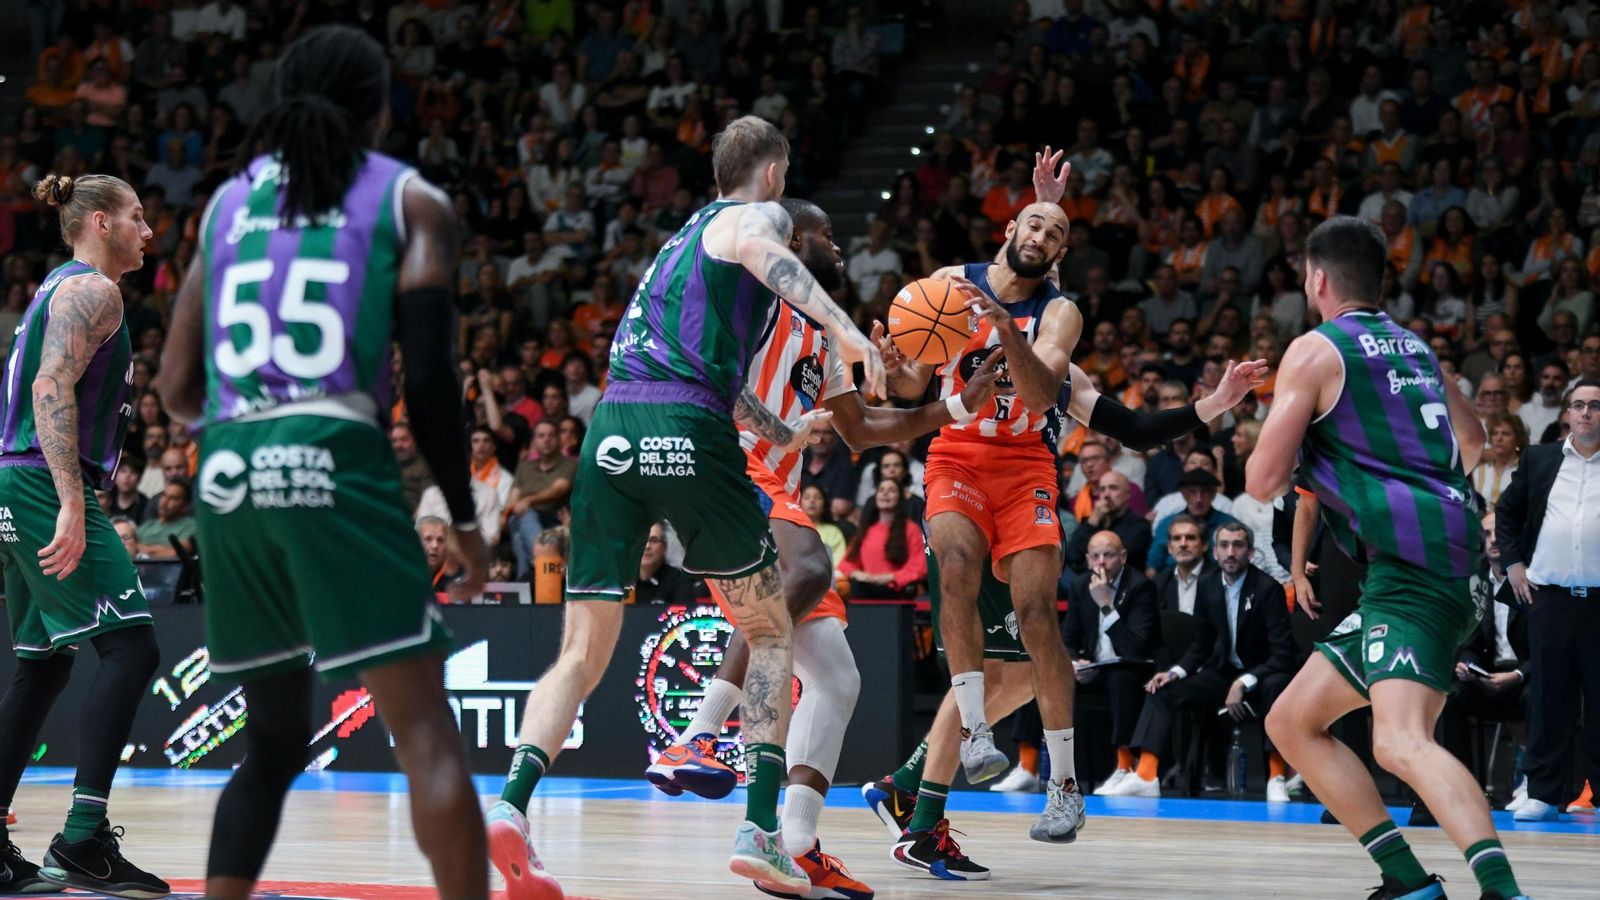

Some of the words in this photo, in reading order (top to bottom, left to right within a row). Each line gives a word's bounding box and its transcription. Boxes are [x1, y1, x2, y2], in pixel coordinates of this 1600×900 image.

[214, 258, 350, 379] 55
[251, 444, 336, 472] COSTA
[639, 452, 665, 464] DEL
[666, 452, 696, 464] SOL
[640, 437, 695, 451] COSTA
[249, 469, 290, 491] DEL
[290, 468, 337, 491] SOL
[640, 464, 696, 476] MÁLAGA
[152, 646, 212, 711] 12
[163, 692, 249, 766] LOTU
[745, 751, 758, 786] UNICAJA
